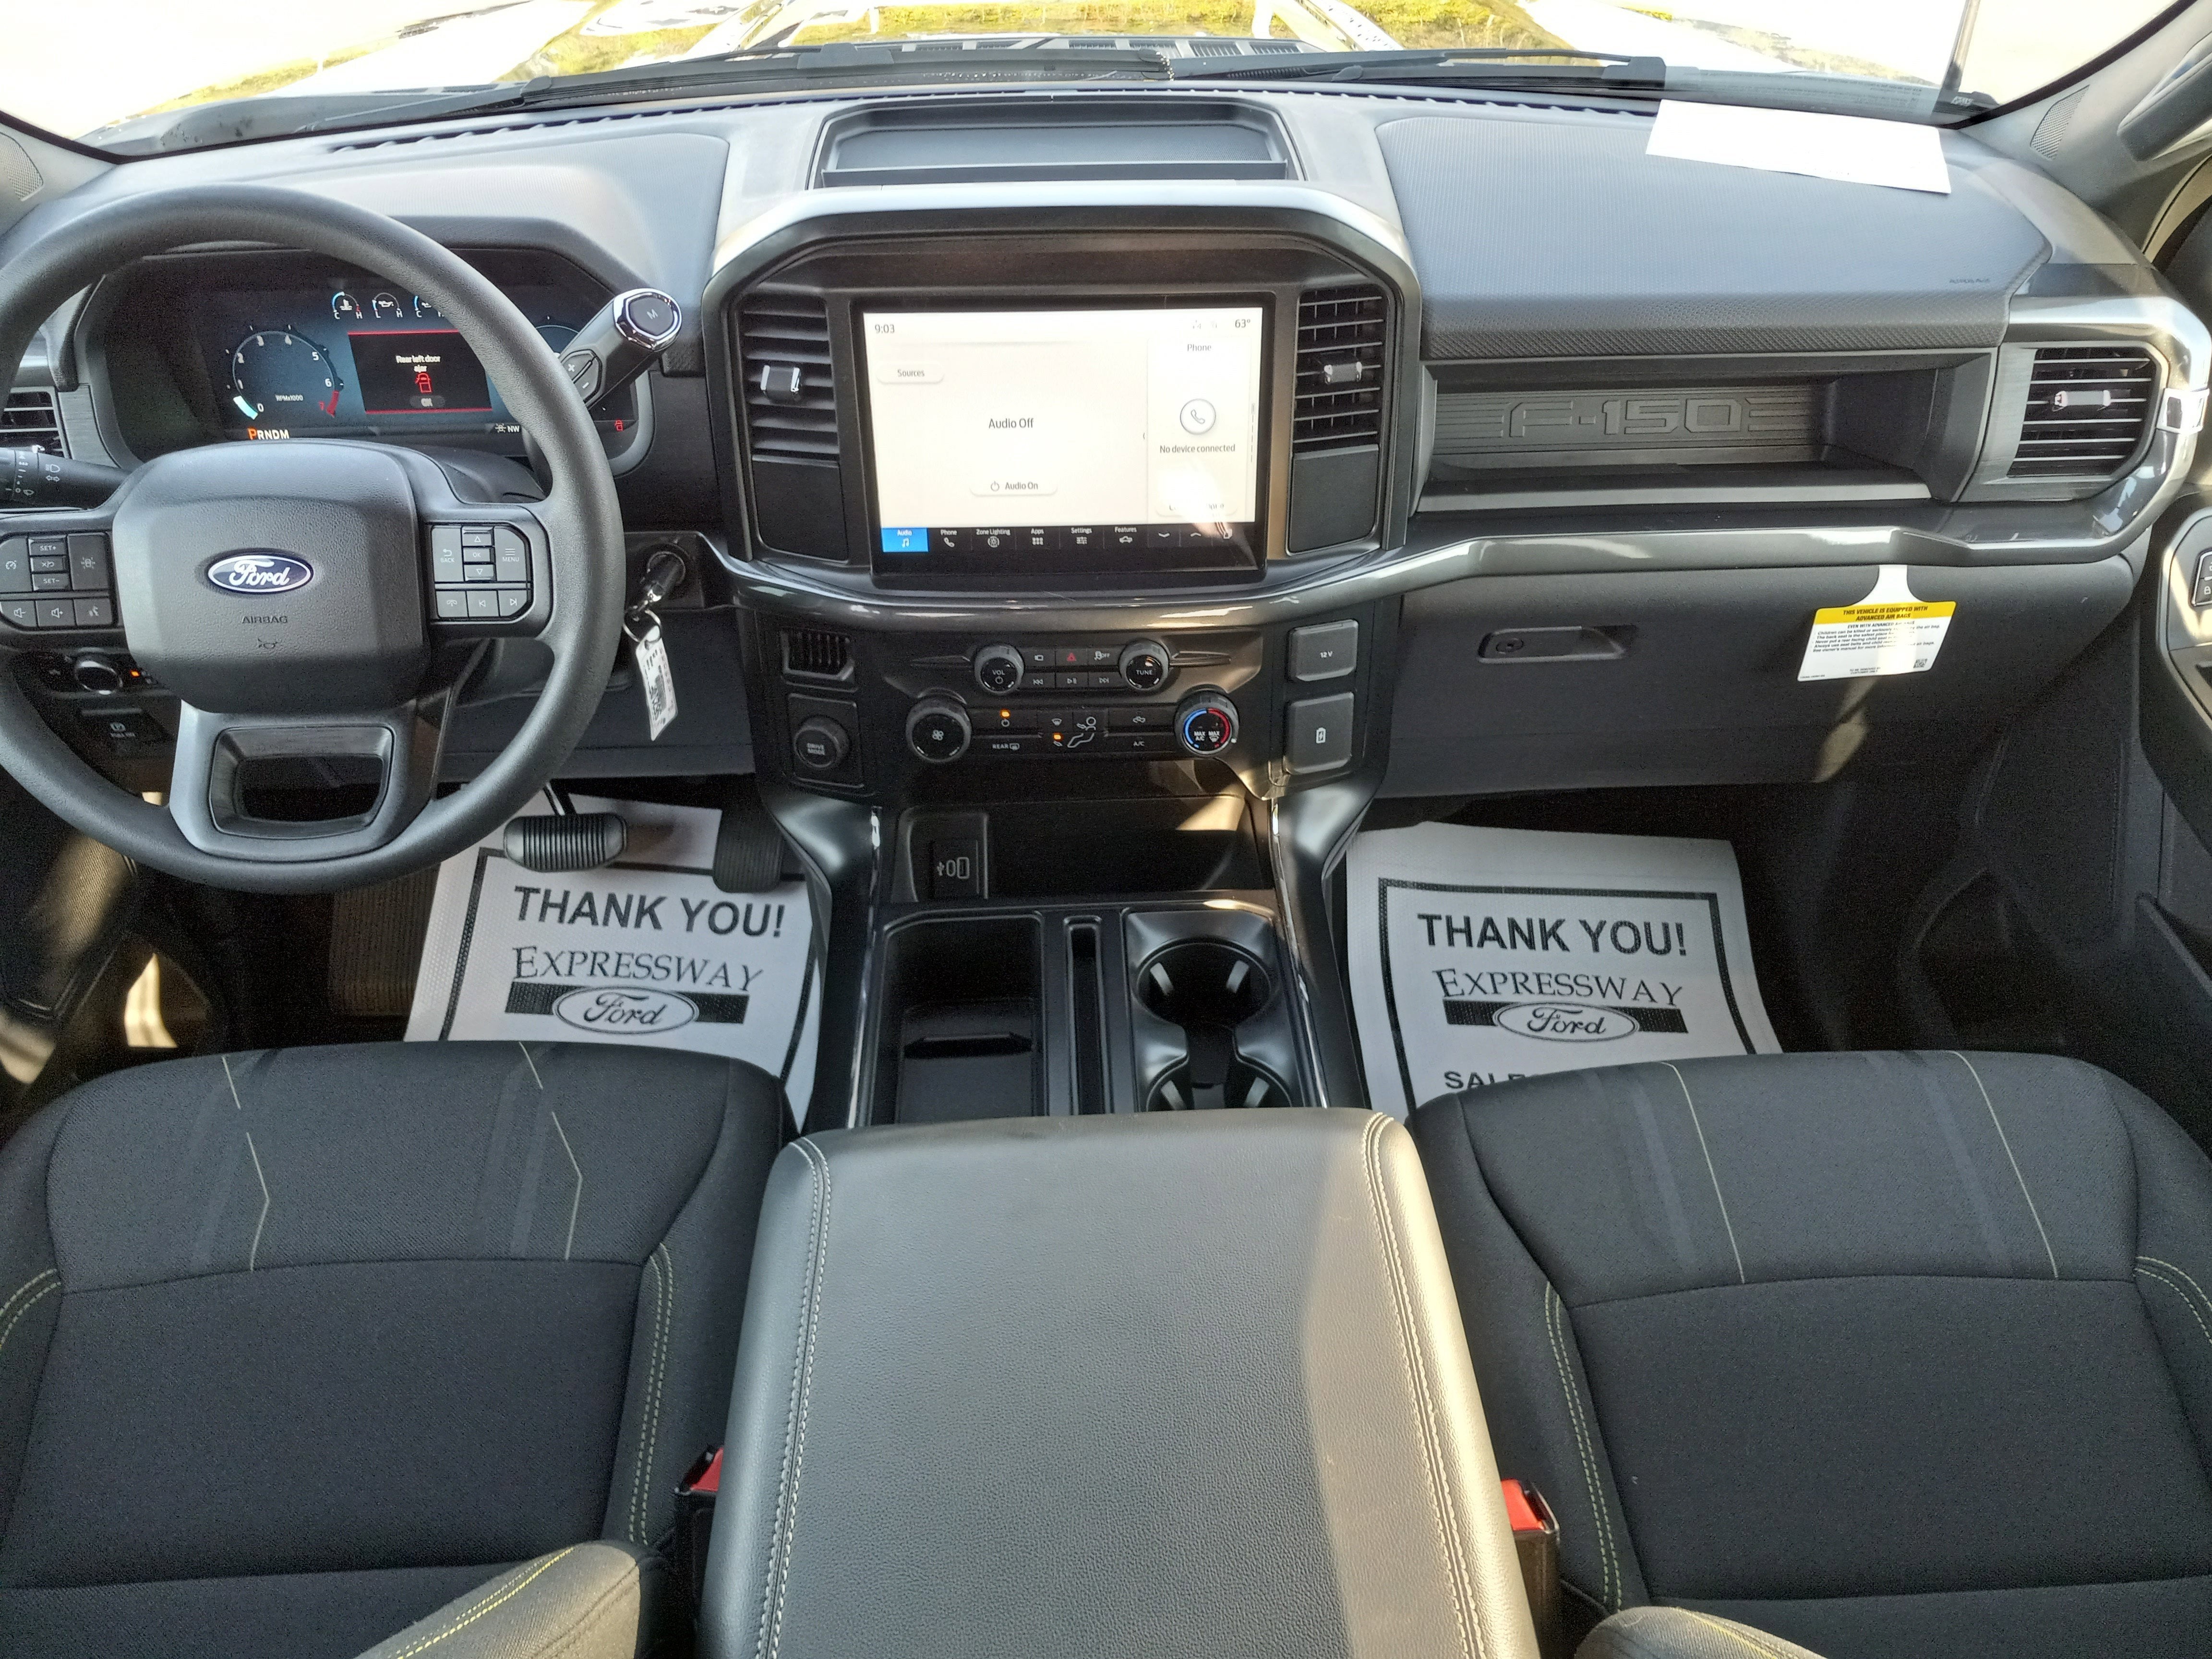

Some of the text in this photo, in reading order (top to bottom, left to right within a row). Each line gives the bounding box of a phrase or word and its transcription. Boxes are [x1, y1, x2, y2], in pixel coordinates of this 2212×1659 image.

[647, 309, 659, 320] M
[875, 324, 895, 334] 9:03
[1187, 344, 1212, 352] Phone
[312, 352, 319, 361] 5
[897, 369, 925, 377] Sources
[325, 378, 332, 387] 6
[257, 403, 264, 412] 0
[1509, 397, 1743, 438] F-150
[988, 418, 1034, 429] Audio Off
[1159, 444, 1236, 453] No device connected
[1005, 481, 1038, 490] Audio On
[228, 558, 290, 586] Ford
[241, 615, 288, 624] AIRBAG
[515, 886, 785, 938] THANK YOU!
[1418, 914, 1687, 956] THANK YOU!
[512, 946, 764, 992] EXPRESSWAY
[1432, 969, 1683, 1006] EXPRESSWAY
[584, 992, 666, 1032] Ford
[1527, 1008, 1606, 1034] Ford
